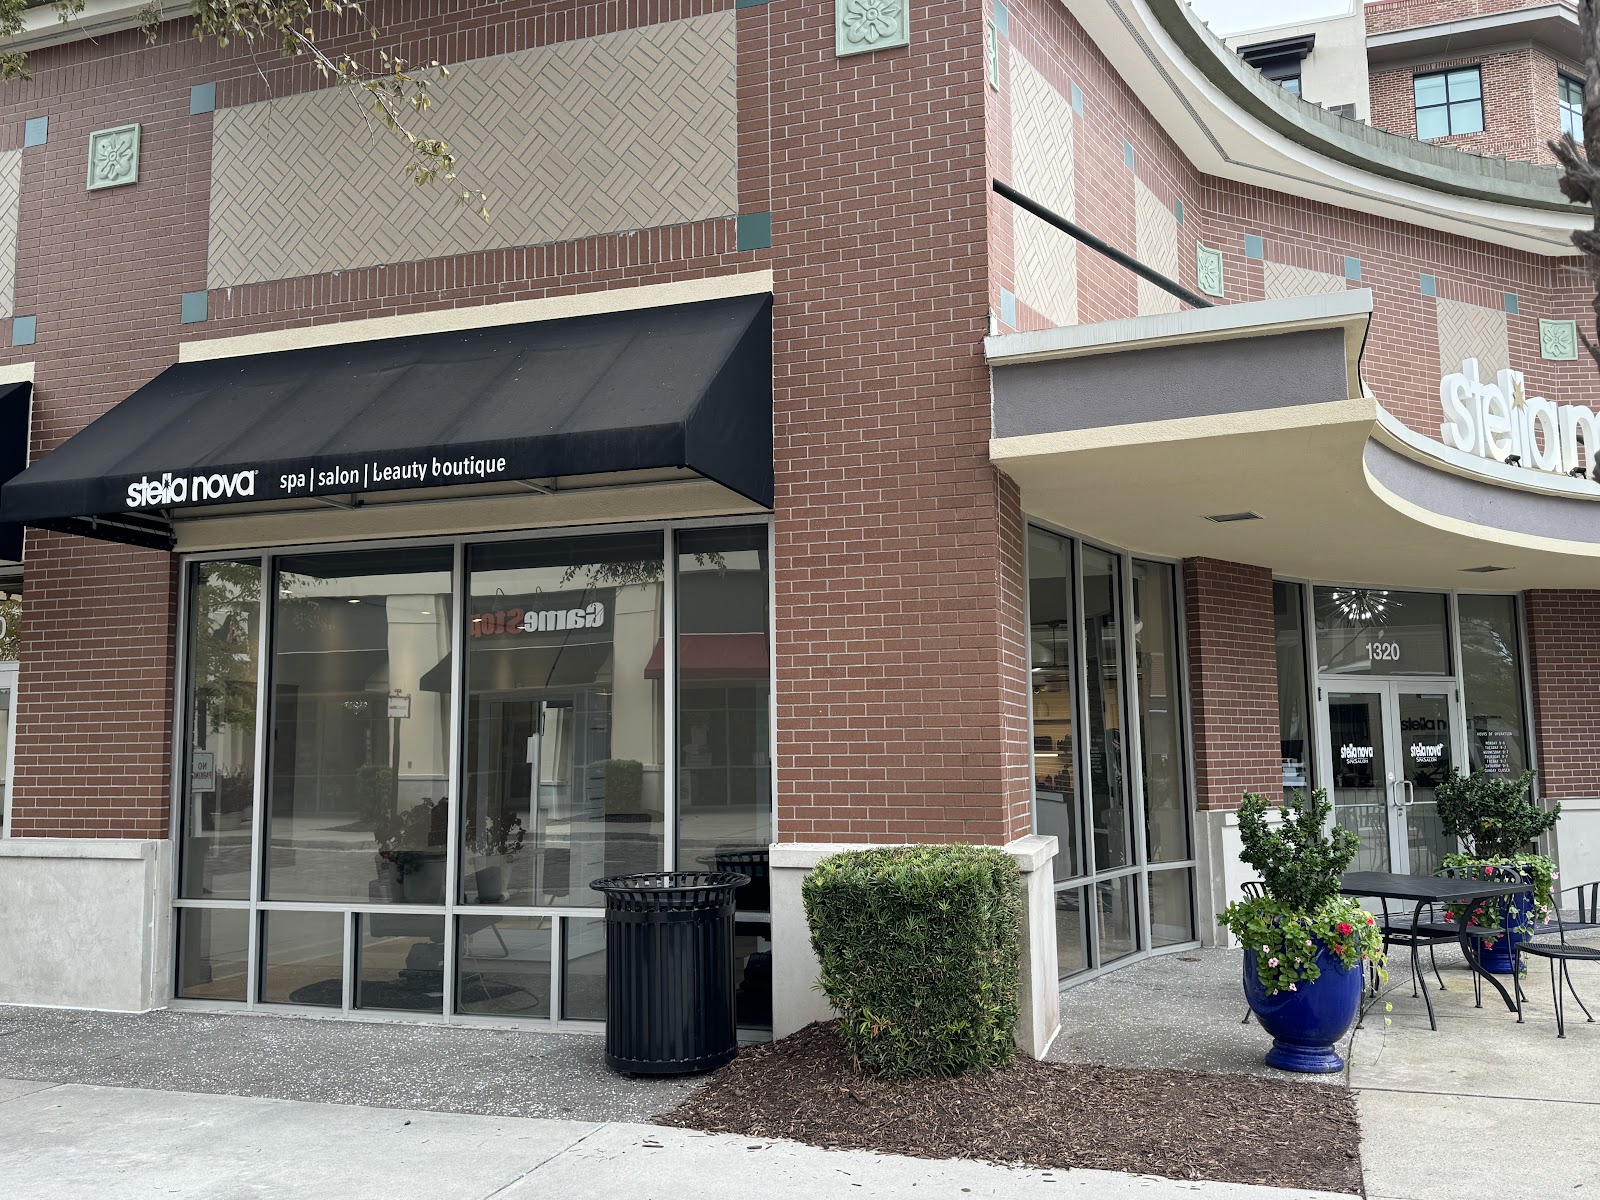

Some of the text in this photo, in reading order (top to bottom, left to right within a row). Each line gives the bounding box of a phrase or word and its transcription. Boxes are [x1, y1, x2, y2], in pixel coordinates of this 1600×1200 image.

[1440, 357, 1562, 473] stella
[126, 472, 187, 507] stella
[279, 472, 306, 493] spa
[318, 465, 360, 487] salon
[373, 462, 427, 482] beauty
[432, 455, 506, 477] boutique
[1366, 642, 1400, 660] 1320
[1400, 716, 1436, 731] stella
